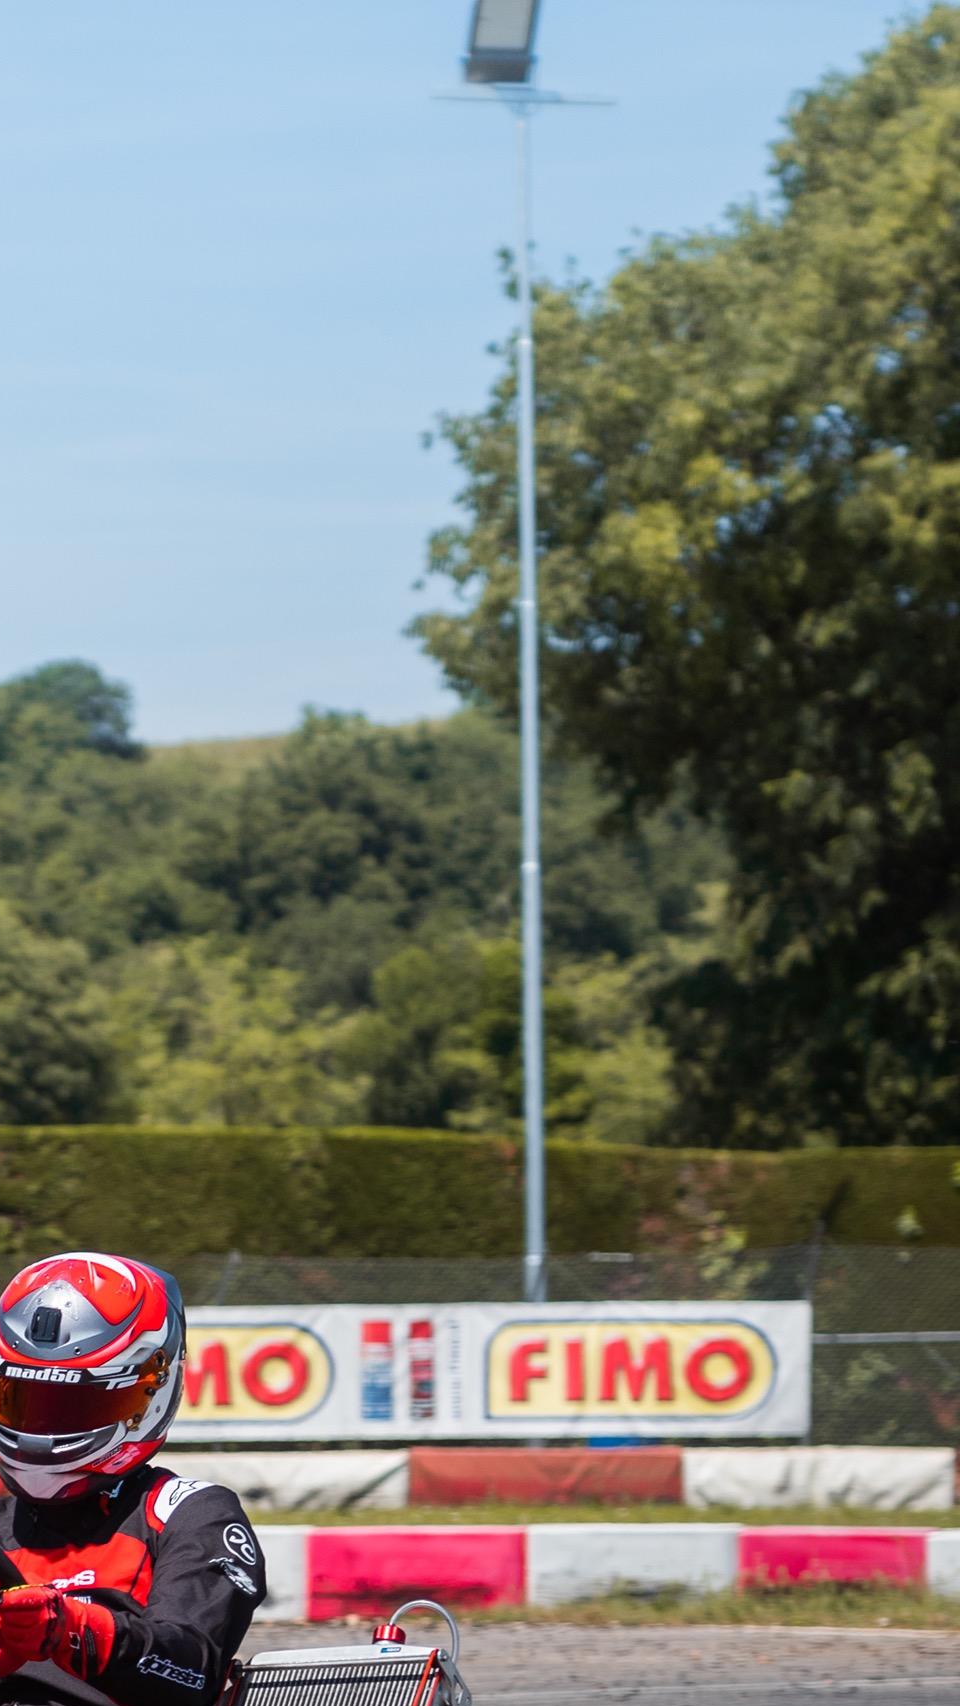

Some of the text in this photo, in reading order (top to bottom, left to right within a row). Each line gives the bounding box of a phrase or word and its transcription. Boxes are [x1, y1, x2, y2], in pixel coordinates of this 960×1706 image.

[5, 1365, 81, 1384] mad56
[184, 1340, 310, 1407] MO
[509, 1337, 754, 1403] FIMO
